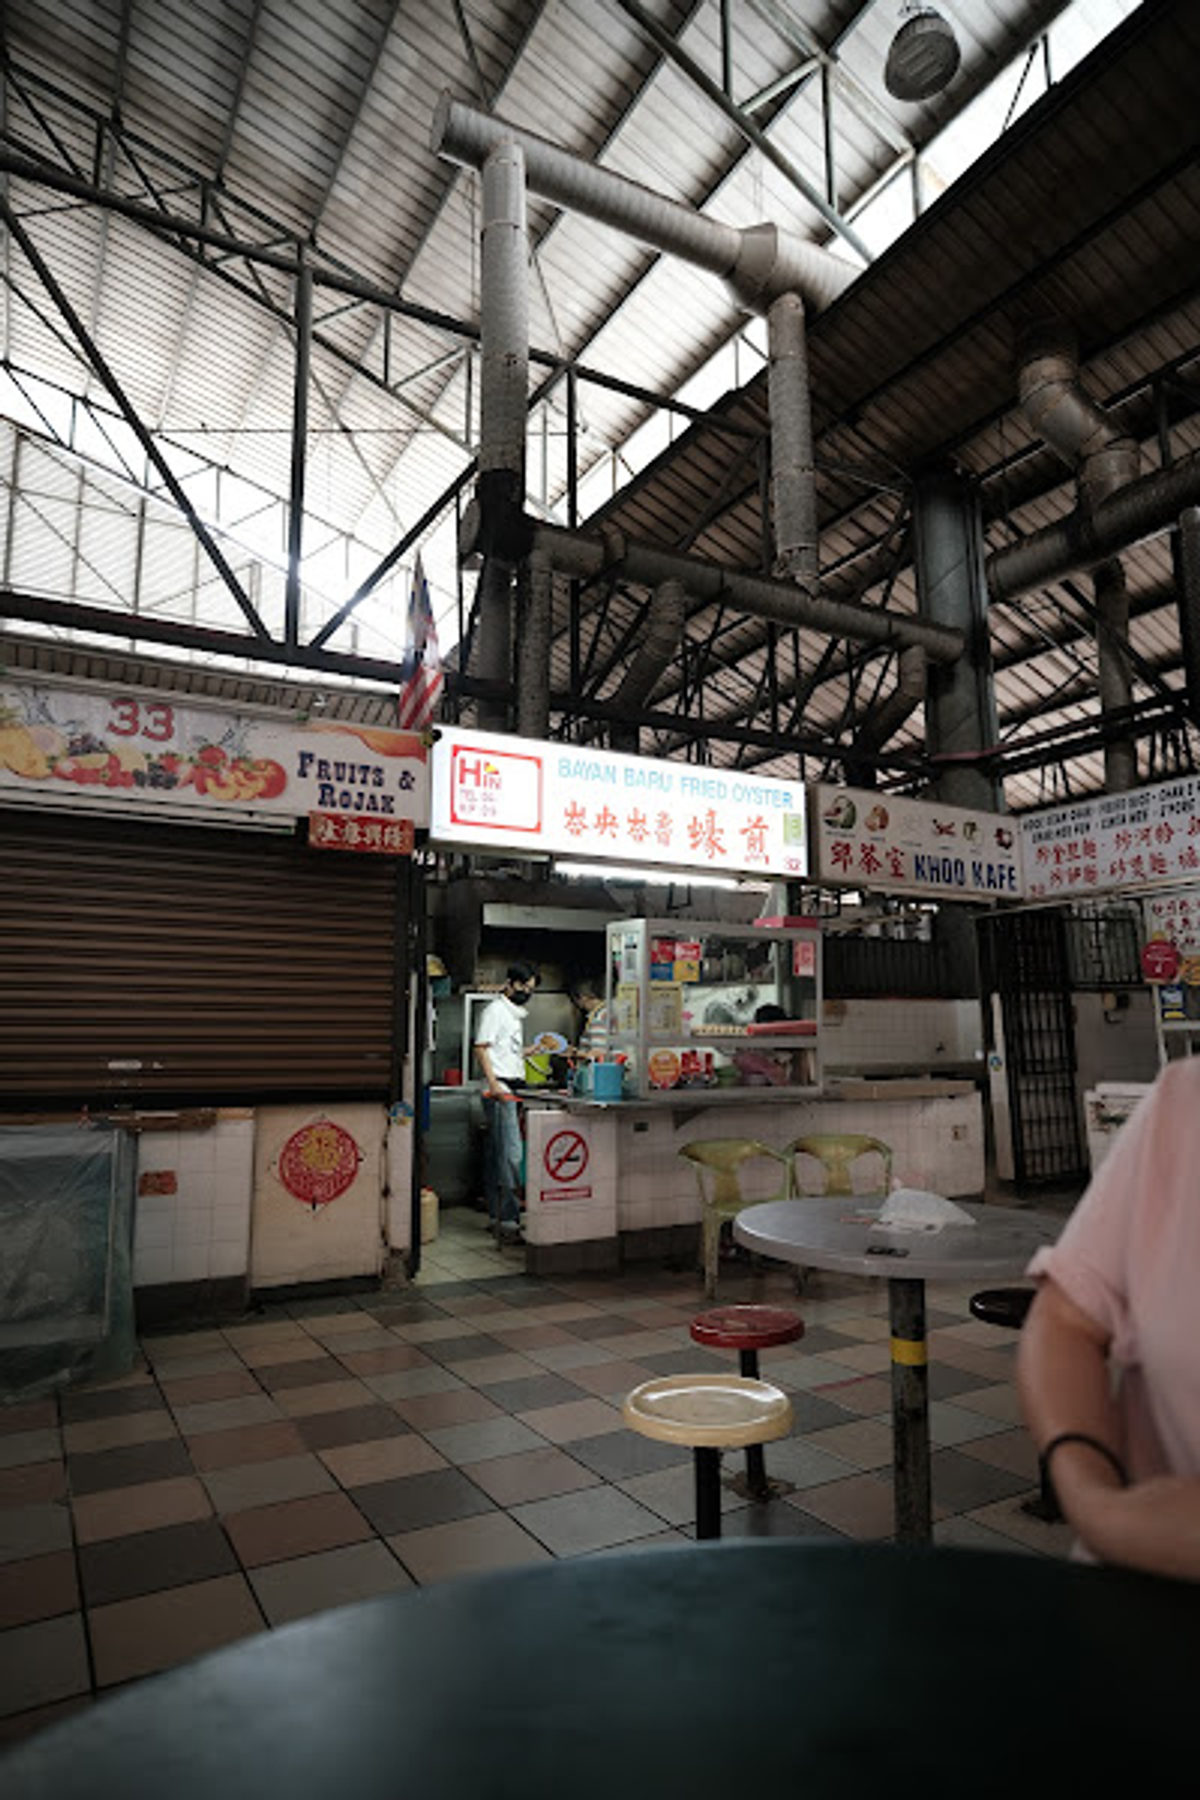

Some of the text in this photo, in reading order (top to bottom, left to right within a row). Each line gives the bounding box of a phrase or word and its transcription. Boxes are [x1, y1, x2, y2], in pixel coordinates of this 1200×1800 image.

[107, 699, 175, 742] 33
[297, 750, 416, 792] FRUITS &
[557, 757, 794, 810] BAYAN BARU FRIED OYSTER
[317, 783, 395, 814] ROJAK
[914, 853, 1018, 892] KHOO KAFE
